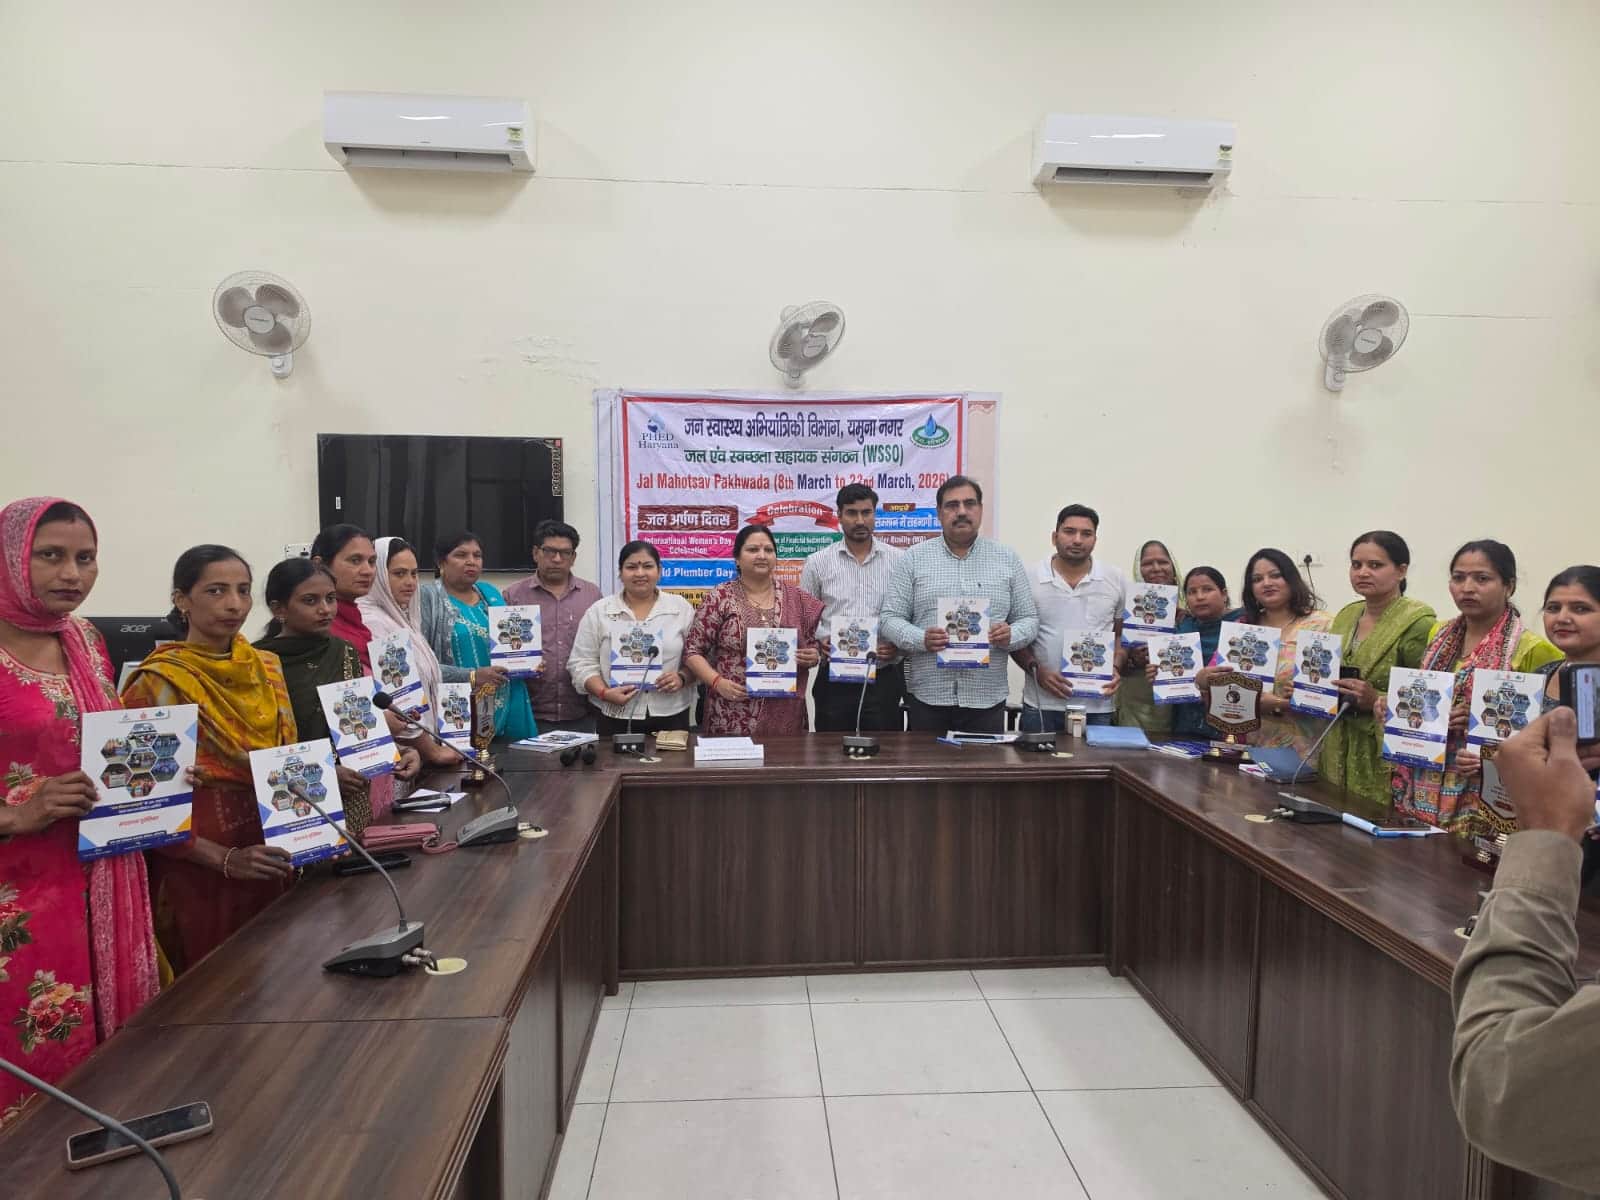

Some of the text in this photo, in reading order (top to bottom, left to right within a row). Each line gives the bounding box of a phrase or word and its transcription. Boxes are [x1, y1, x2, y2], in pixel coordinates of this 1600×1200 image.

[684, 418, 703, 436] जन
[706, 418, 742, 437] स्वास्थ्य
[745, 412, 804, 437] अभियांत्रिकी
[848, 419, 876, 445] यमुना
[879, 419, 904, 437] नगर
[642, 433, 674, 441] PHED
[638, 441, 679, 449] Haryana
[684, 449, 706, 462] जल
[730, 450, 771, 463] स्वच्छता
[775, 450, 817, 465] सहायक
[821, 446, 859, 464] संगठन
[863, 444, 904, 467] (WSSO)
[637, 473, 653, 489] Jal
[657, 473, 710, 489] Mahotsav
[714, 473, 769, 490] Pakhwada
[774, 473, 794, 493] (8th
[797, 473, 831, 489] March
[835, 474, 845, 488] to
[878, 473, 915, 491] March,
[767, 504, 823, 516] Celebration
[644, 510, 730, 526] जल अर्पण दिवस
[644, 536, 687, 545] International
[719, 536, 732, 546] Day
[673, 568, 713, 577] Plumber
[716, 568, 734, 579] Day
[120, 624, 152, 633] acer
